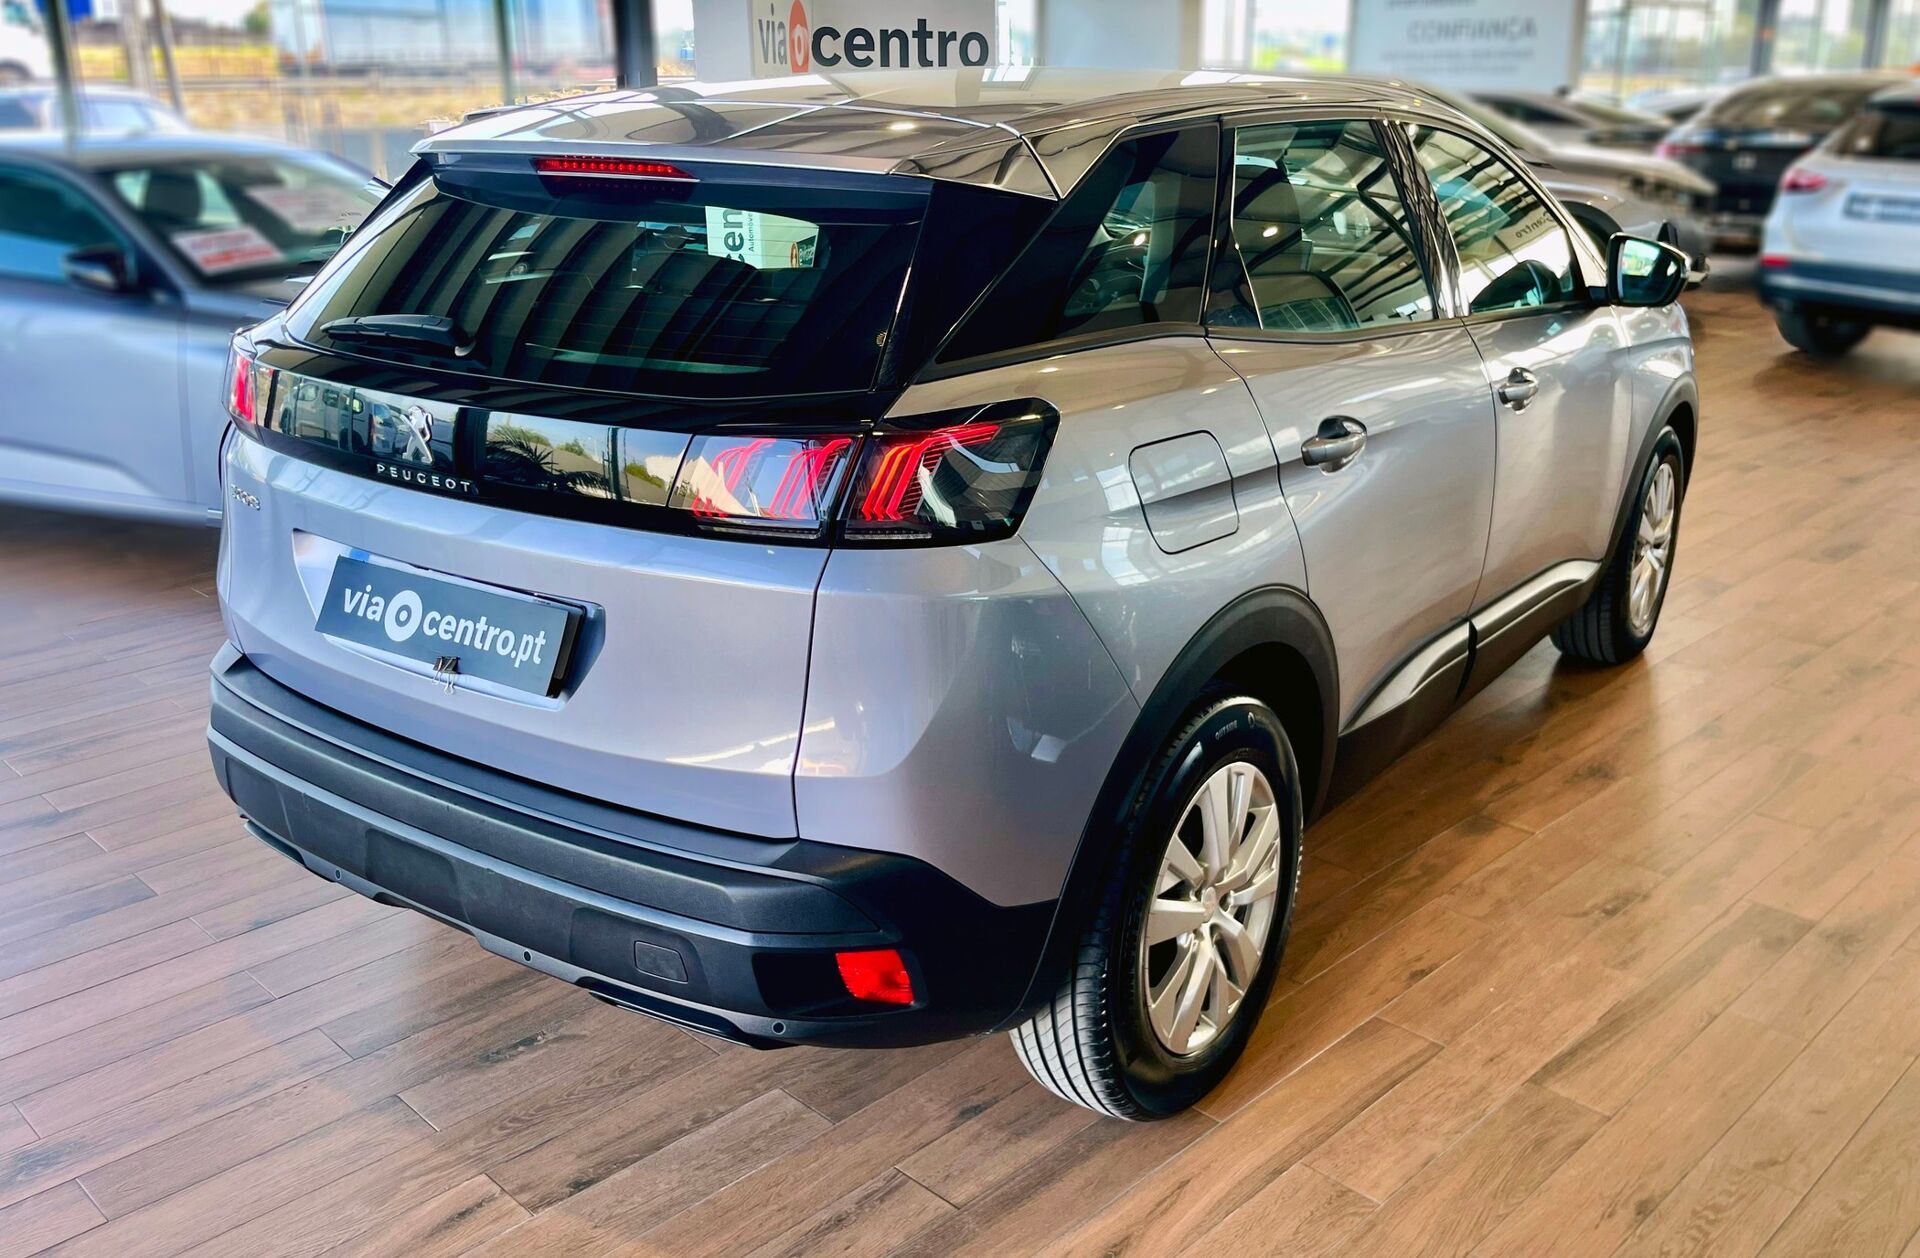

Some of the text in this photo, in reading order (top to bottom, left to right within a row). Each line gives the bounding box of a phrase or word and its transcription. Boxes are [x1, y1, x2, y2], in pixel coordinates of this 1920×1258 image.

[758, 3, 989, 67] via centro
[376, 463, 471, 492] PEUGEOT
[422, 609, 547, 668] centro.pt
